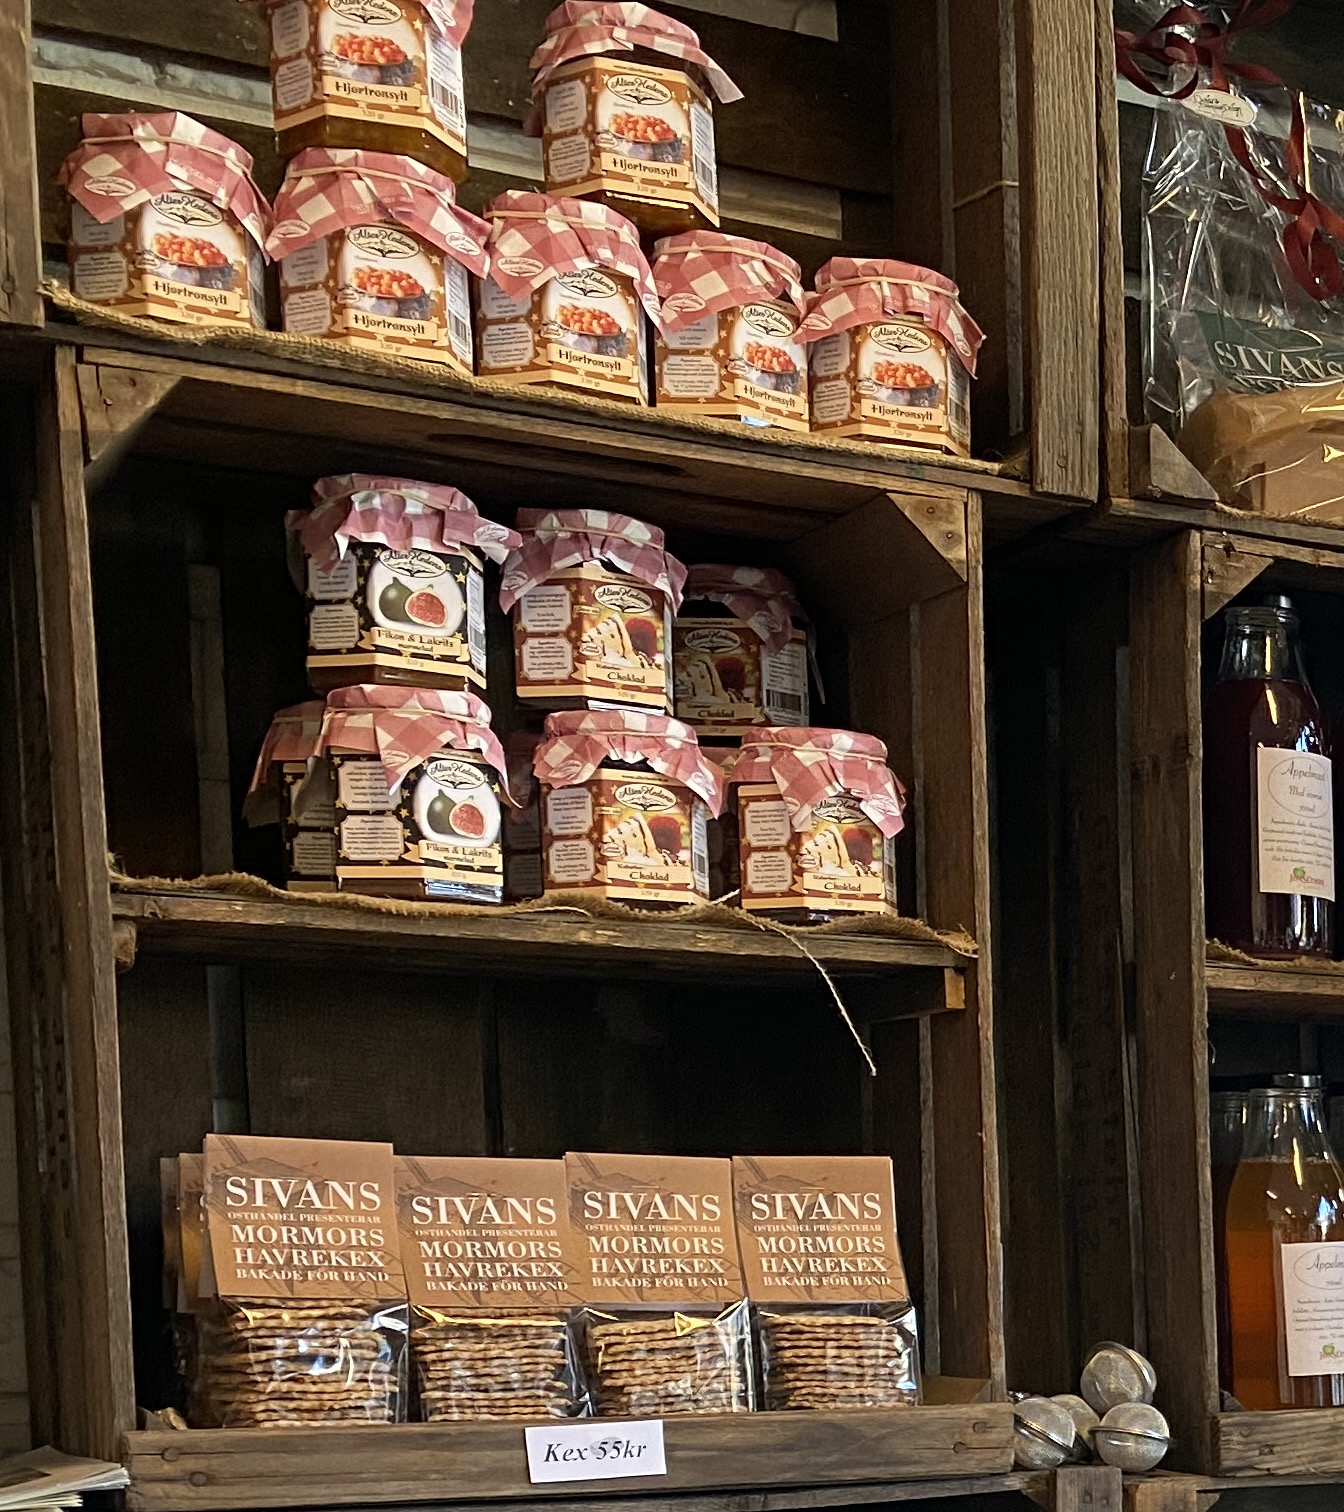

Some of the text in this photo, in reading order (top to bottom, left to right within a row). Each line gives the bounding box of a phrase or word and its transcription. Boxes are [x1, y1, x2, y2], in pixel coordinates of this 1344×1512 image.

[612, 158, 678, 177] Hjortronsylt
[153, 281, 227, 305] Hjortronsylt
[353, 314, 425, 336] Hjortronsylt
[558, 350, 621, 372] Hjortronsylt
[226, 1176, 381, 1211] SIVANS
[412, 1196, 556, 1226] SIVANS
[583, 1190, 721, 1221] SIVANS
[751, 1192, 882, 1220] SIVANS
[231, 1225, 385, 1247] MORMORS
[588, 1236, 724, 1255] MORMORS
[757, 1237, 885, 1254] MORMORS
[233, 1248, 385, 1267] HAVREKEX
[420, 1240, 562, 1259] MORMORS
[424, 1262, 564, 1278] HAVREKEX
[591, 1258, 725, 1273] HAVREKEX
[760, 1257, 888, 1273] HAVREKEX
[236, 1268, 390, 1282] BAKADE FÖR HAND
[592, 1275, 728, 1288] BAKADE FÖR HAND
[763, 1274, 891, 1287] BAKADE FÖR HAND
[426, 1278, 568, 1293] BAKADE FÖR HAND
[543, 1440, 647, 1462] Kex 55kr
